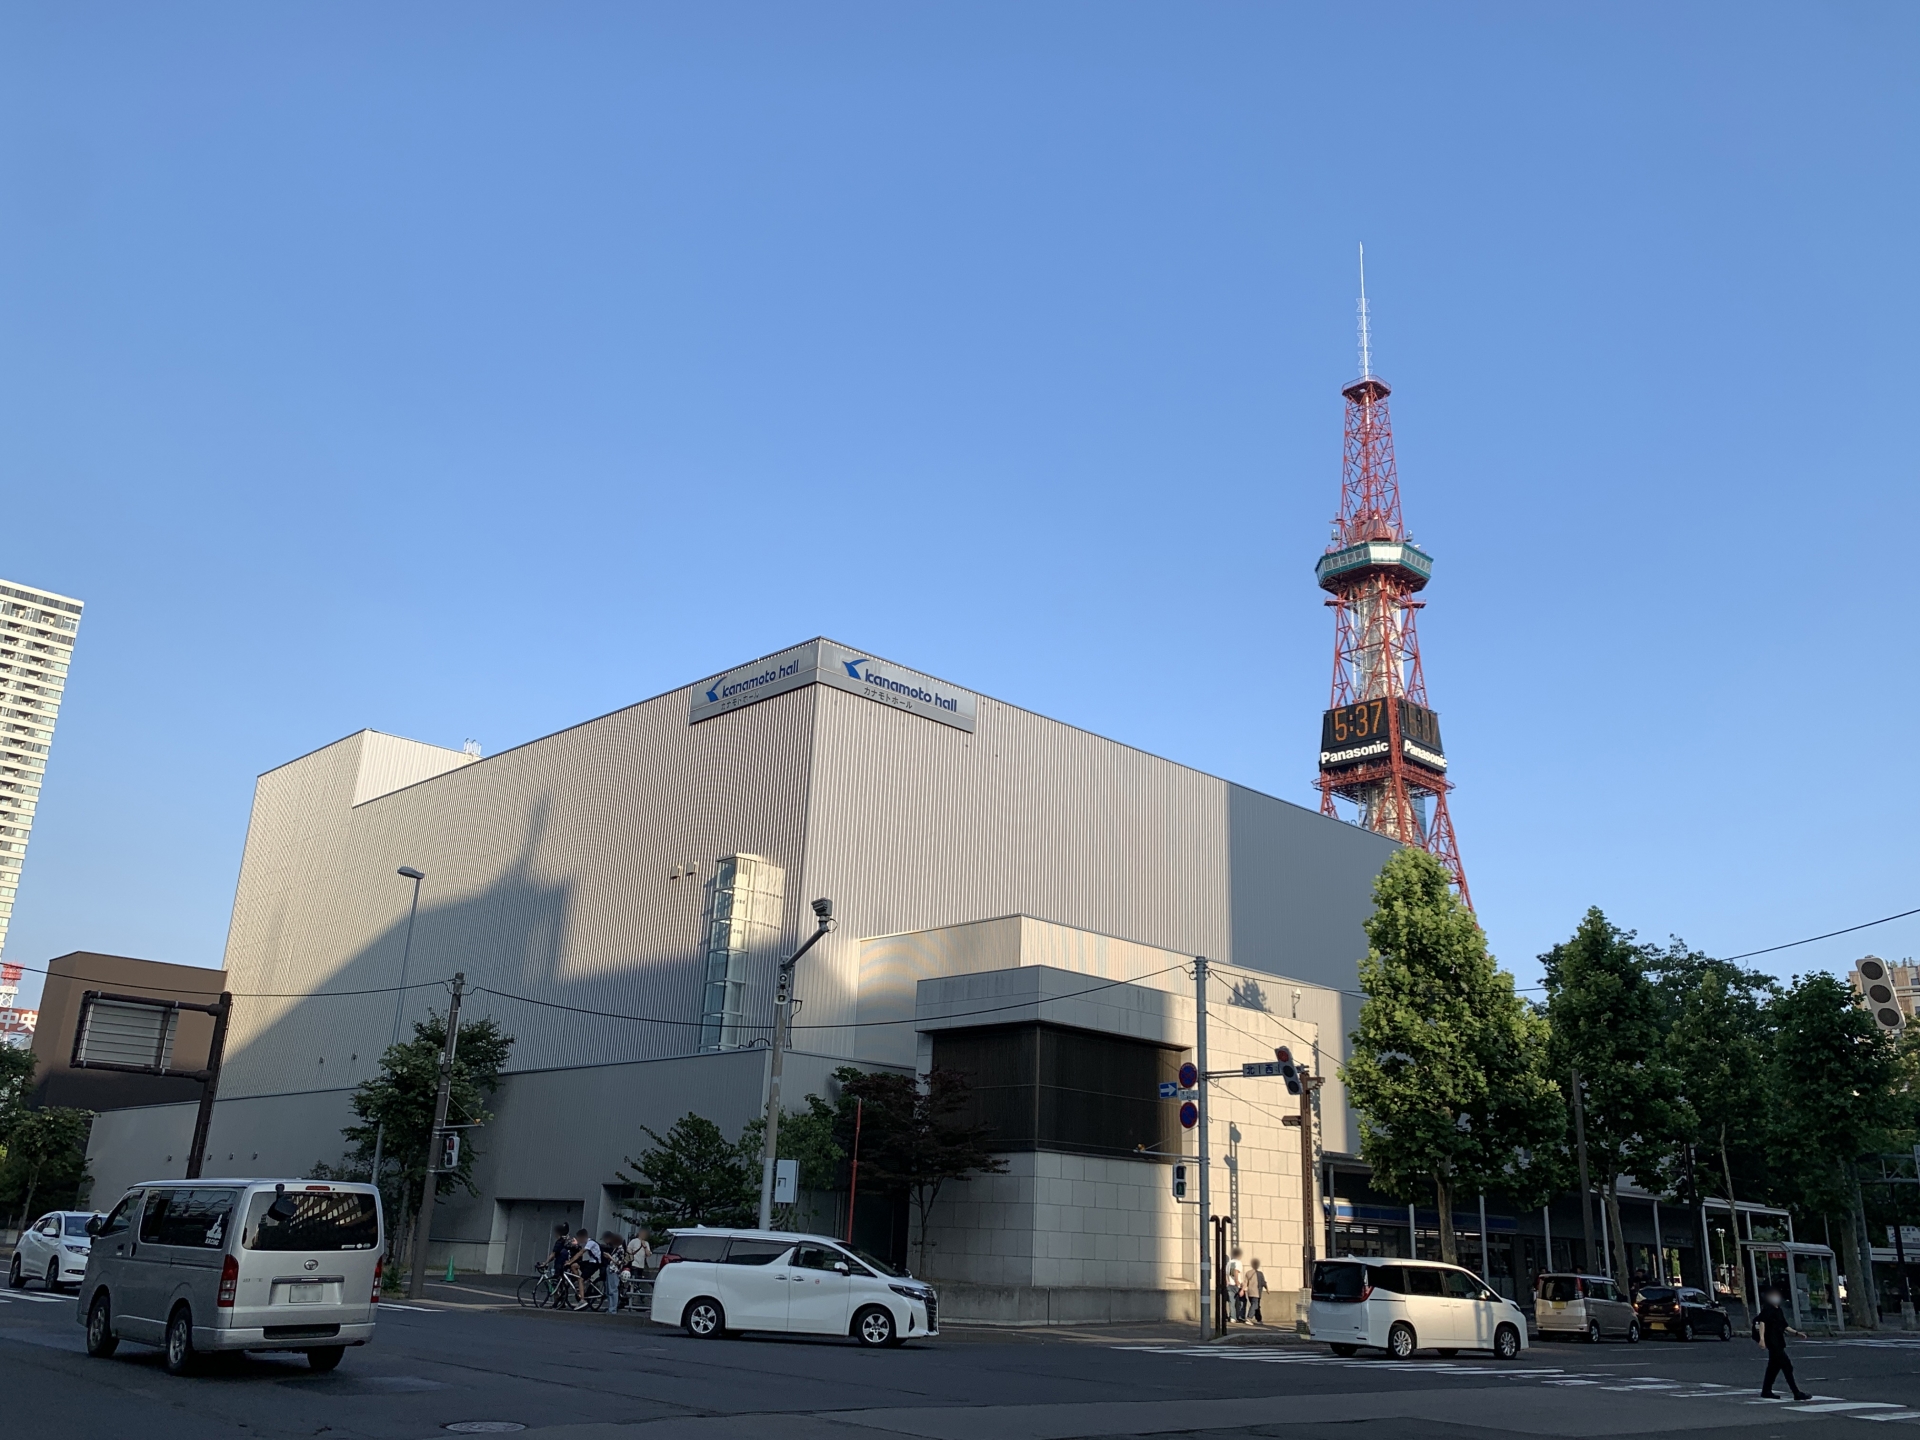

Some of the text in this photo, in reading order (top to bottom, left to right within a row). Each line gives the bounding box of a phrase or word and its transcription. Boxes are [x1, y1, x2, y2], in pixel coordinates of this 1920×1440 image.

[722, 659, 799, 698] kanamoto hall
[865, 668, 957, 713] kanamoto hall
[864, 686, 913, 709] カナモトホール
[1334, 701, 1383, 741] 5:37
[1320, 740, 1389, 764] Panasonic
[1404, 739, 1448, 768] Panasonic
[0, 1009, 38, 1032] 中央
